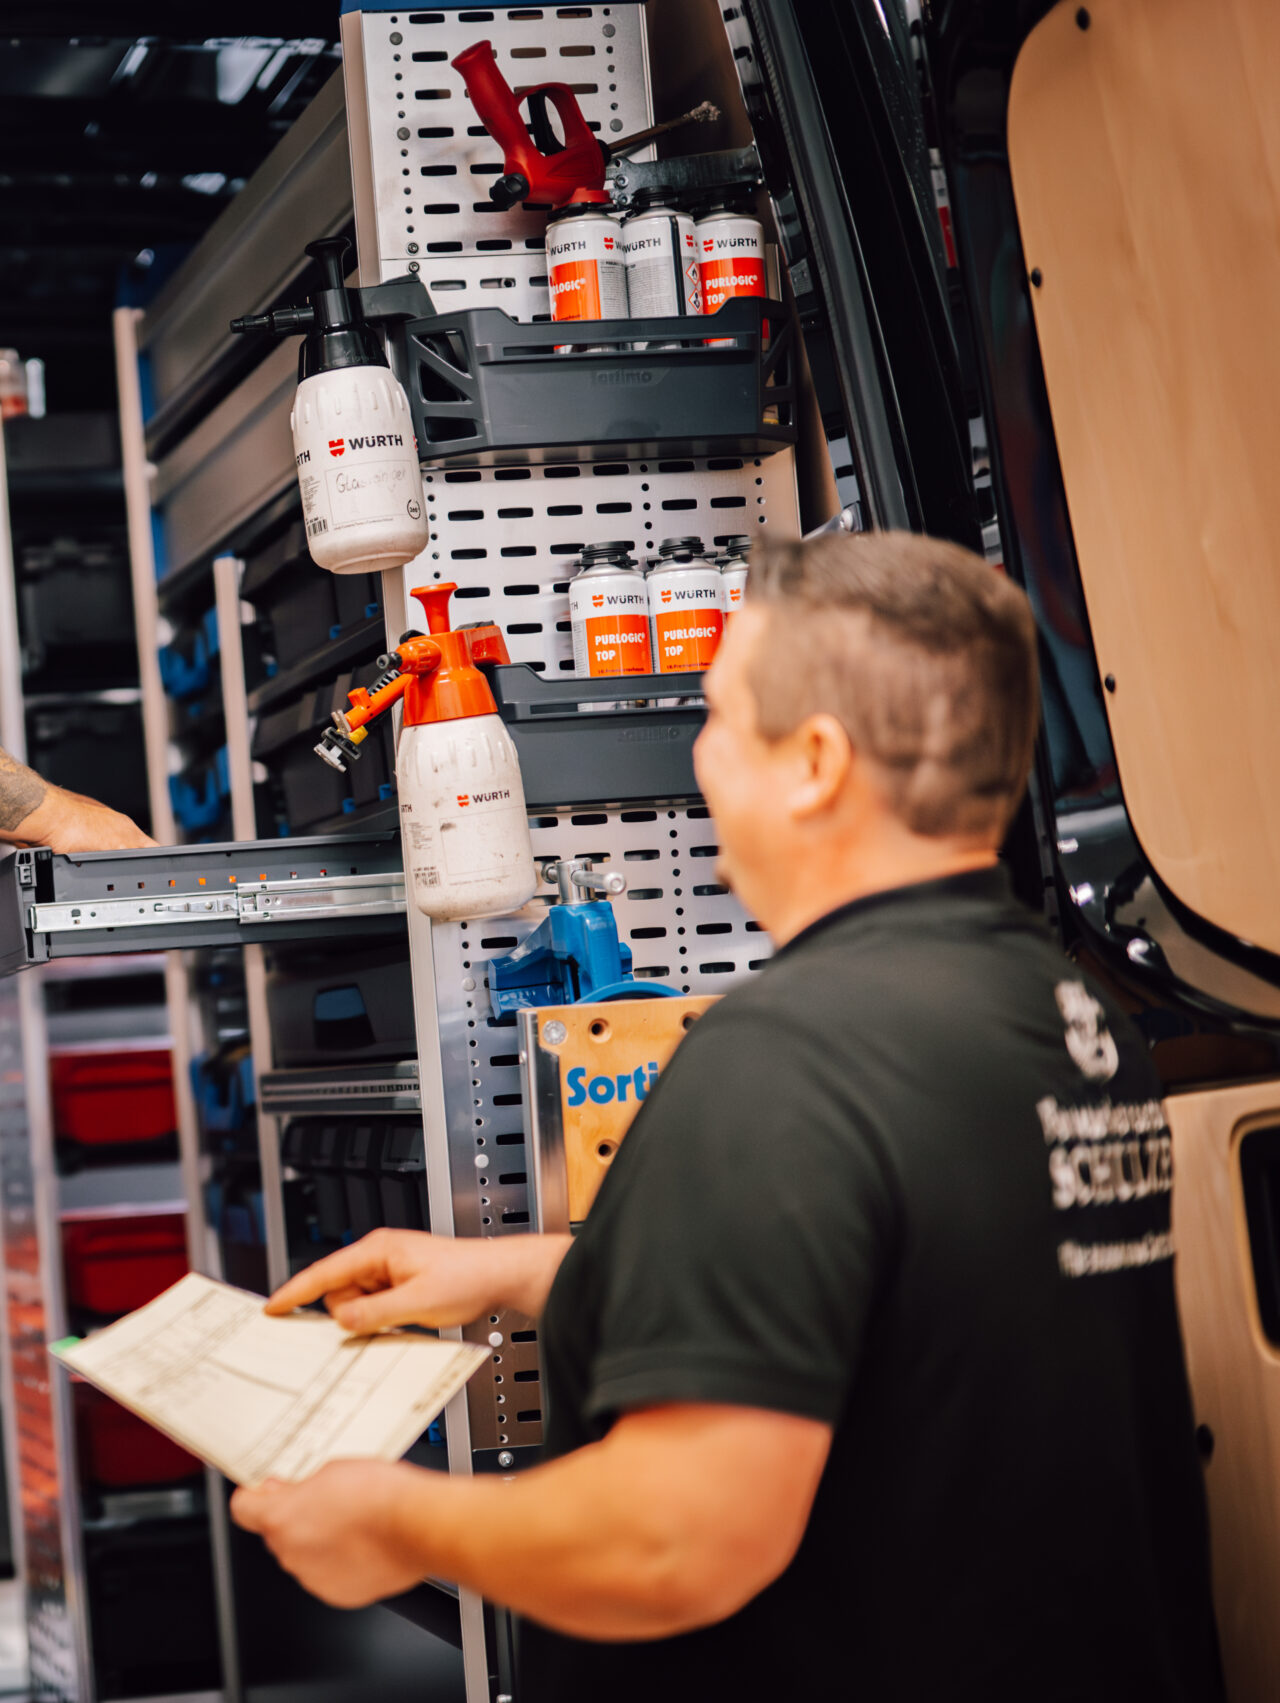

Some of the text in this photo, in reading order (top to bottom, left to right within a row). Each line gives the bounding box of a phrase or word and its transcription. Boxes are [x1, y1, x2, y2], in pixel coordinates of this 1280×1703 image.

[716, 238, 758, 249] WÜRTH
[706, 292, 726, 306] TOP
[349, 434, 403, 450] WÜRTH
[606, 594, 645, 606] WÜRTH
[674, 589, 716, 600] WÜRTH
[595, 649, 617, 662] TOP
[664, 645, 684, 657] TOP
